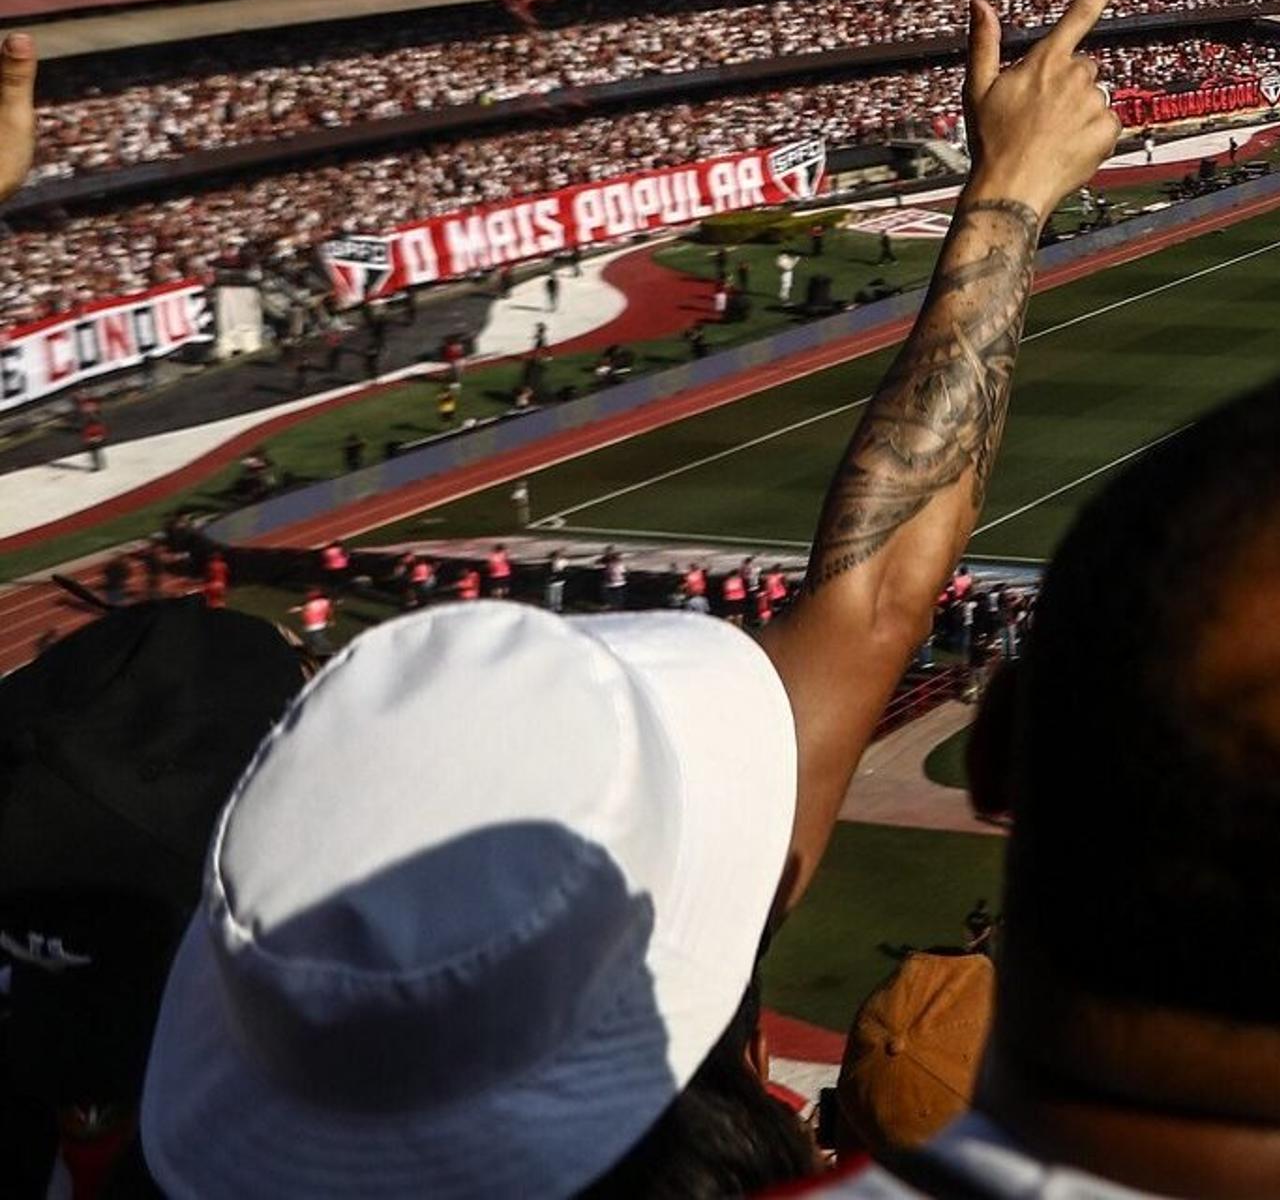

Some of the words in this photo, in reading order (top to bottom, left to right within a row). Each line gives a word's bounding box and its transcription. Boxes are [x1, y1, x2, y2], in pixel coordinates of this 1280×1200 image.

[401, 233, 440, 284] O
[445, 197, 566, 271] MAIS
[573, 156, 766, 243] POPULAR
